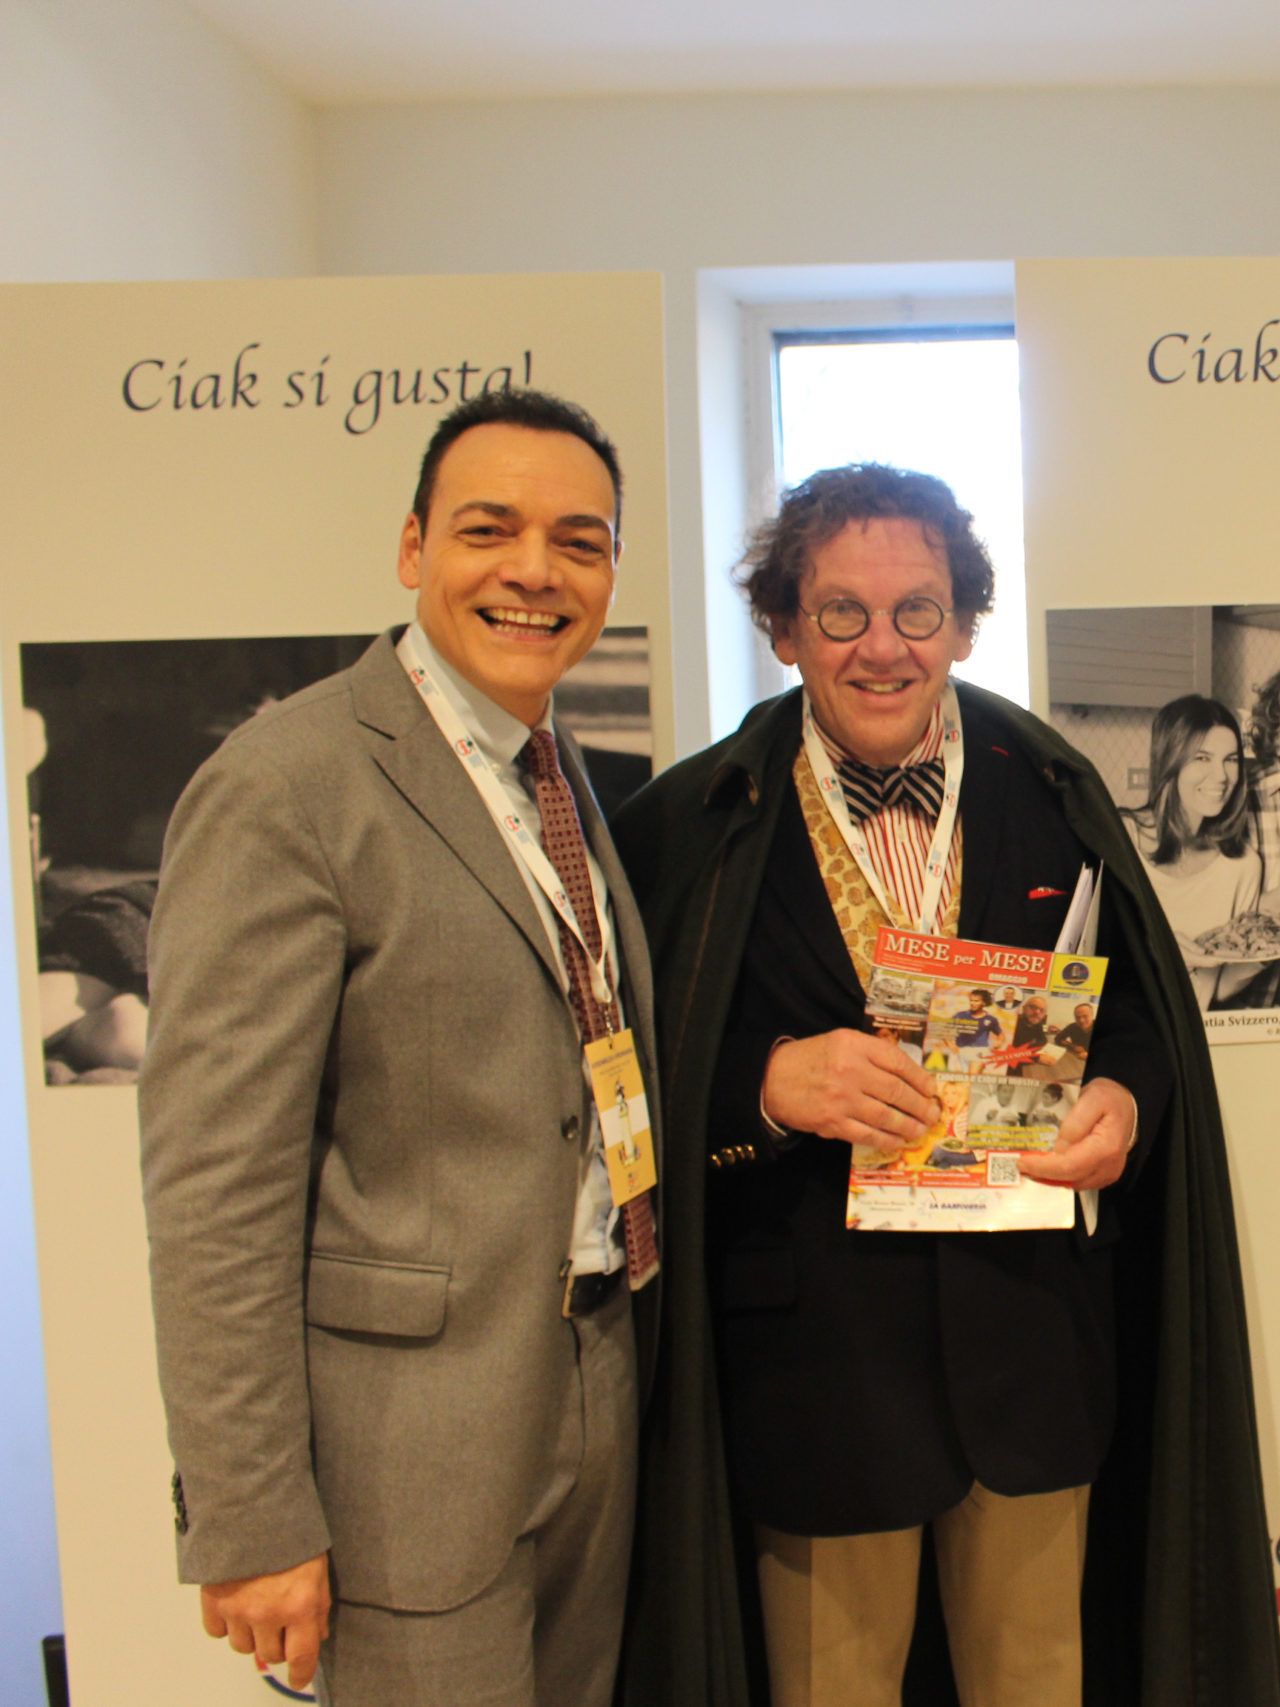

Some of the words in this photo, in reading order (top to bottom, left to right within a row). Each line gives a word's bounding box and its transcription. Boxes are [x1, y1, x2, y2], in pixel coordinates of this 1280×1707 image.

[122, 342, 261, 412] Ciak
[283, 354, 331, 409] si
[883, 933, 950, 961] MESE
[953, 953, 976, 965] per
[979, 949, 1046, 974] MESE
[1228, 1014, 1280, 1027] Svizzero,
